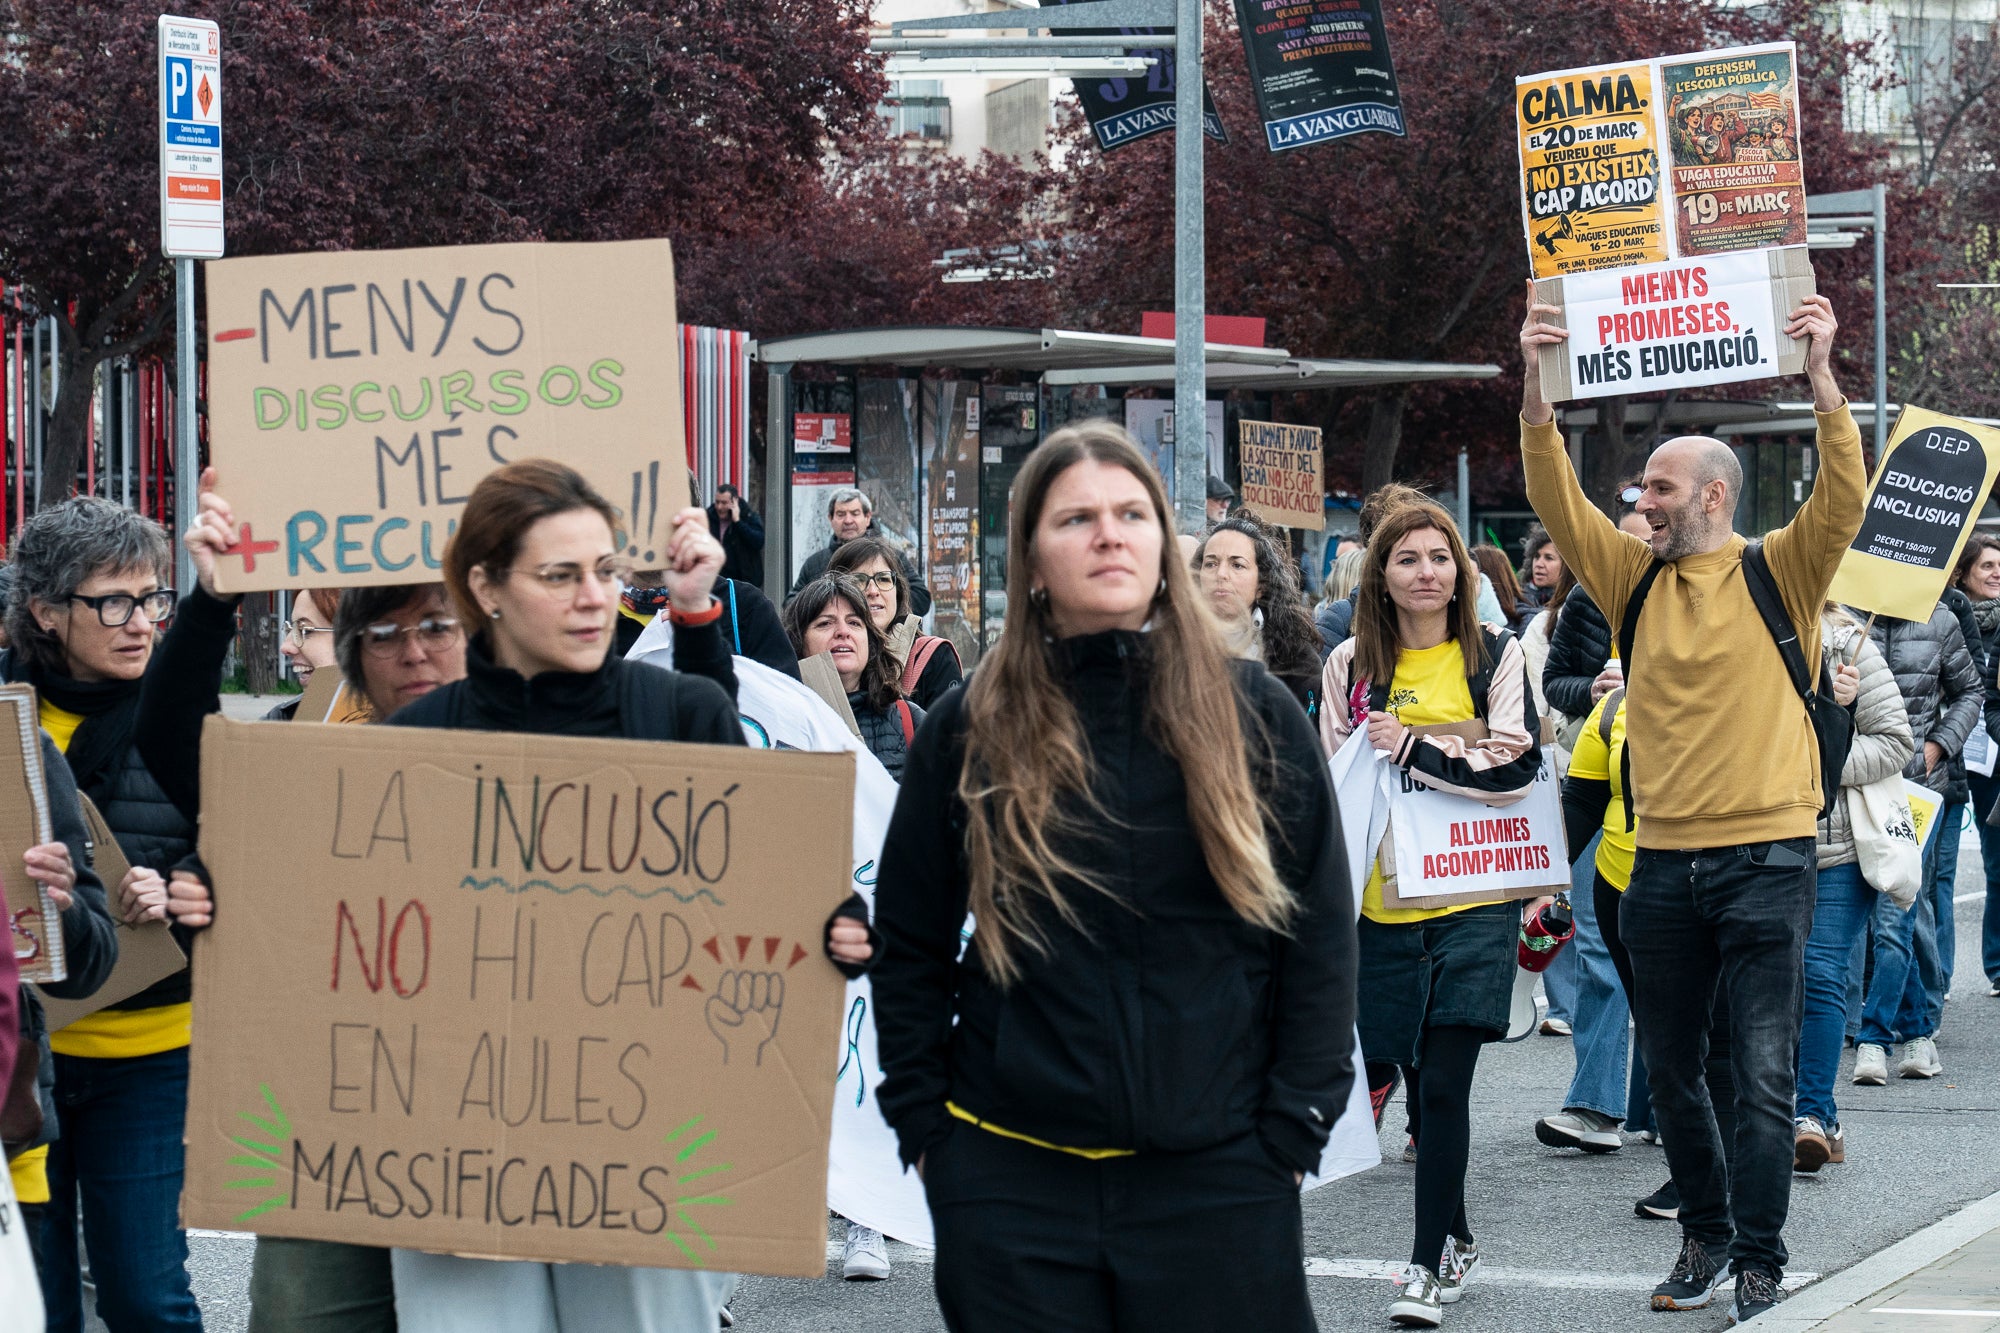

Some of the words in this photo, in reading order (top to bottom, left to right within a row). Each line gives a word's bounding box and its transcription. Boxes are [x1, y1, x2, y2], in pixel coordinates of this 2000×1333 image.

[1275, 4, 1314, 19] QUARTET
[1255, 20, 1287, 35] CLONE
[1310, 24, 1330, 36] NITO
[1330, 21, 1365, 33] FIGUERAS
[1277, 39, 1303, 53] SANT
[1303, 35, 1335, 47] ANDREU
[1282, 49, 1312, 63] PREMI
[1694, 59, 1757, 78] DEFENSEM
[172, 62, 188, 114] P
[1675, 78, 1727, 94] L'ESCOLA
[1727, 70, 1778, 87] PÚBLICA
[1522, 74, 1649, 125] CALMA.
[1102, 119, 1132, 142] LA
[1273, 122, 1303, 144] LA
[1300, 107, 1401, 138] VANGUARDIA
[1530, 136, 1544, 149] EL
[1543, 124, 1576, 151] 20
[1578, 129, 1594, 141] DE
[1596, 121, 1638, 140] MARÇ
[1543, 147, 1590, 164] VEUREU
[1592, 143, 1617, 157] QUE
[1532, 167, 1560, 193] NO
[1563, 152, 1656, 187] EXISTEIX
[1678, 168, 1713, 183] VAGA
[1713, 163, 1778, 179] EDUCATIVA
[1686, 183, 1695, 191] AL
[1725, 175, 1775, 186] OCCIDENTAL!
[1534, 187, 1576, 215] CAP
[1579, 177, 1654, 209] ACORD
[1683, 193, 1720, 226] 19
[1720, 201, 1734, 213] DE
[1735, 190, 1792, 216] MARÇ
[1575, 230, 1608, 243] VAGUES
[1609, 223, 1662, 239] EDUCATIVES
[1710, 225, 1733, 233] EDUCACIÓ
[1623, 237, 1645, 248] MARÇ
[1557, 261, 1570, 271] PER
[1572, 259, 1586, 269] UNA
[1588, 252, 1622, 266] EDUCACIÓ
[1623, 252, 1648, 262] DIGNA,
[1621, 266, 1709, 306] MENYS
[1597, 300, 1740, 346] PROMESES,
[1577, 343, 1633, 386] MÉS
[1639, 327, 1768, 378] EDUCACIÓ.
[254, 358, 625, 431] DISCURSOS
[1242, 422, 1287, 450] L'ALUMNAT
[1289, 427, 1318, 452] D'AVUI
[1925, 431, 1971, 456] D.E.P
[1242, 445, 1254, 464] LA
[1255, 447, 1295, 471] SOCIETAT
[1297, 453, 1316, 474] DEL
[1267, 468, 1281, 488] NO
[1296, 472, 1315, 493] CAP
[1883, 469, 1974, 504] EDUCACIÓ
[933, 507, 940, 520] EL
[940, 507, 969, 520] TRANSPORT
[1872, 493, 1962, 528] INCLUSIVA
[933, 523, 945, 537] QUE
[937, 538, 945, 550] AL
[1867, 544, 1893, 559] SENSE
[1893, 551, 1931, 567] RECURSOS
[1874, 532, 1905, 550] DECRET
[1904, 540, 1937, 555] 150/2017
[331, 768, 411, 863] LA
[1449, 816, 1531, 848] ALUMNES
[1423, 844, 1551, 880] ACOMPANYATS
[330, 897, 432, 1000] NO
[580, 911, 693, 1009] CAP
[328, 1022, 418, 1117] EN
[458, 1031, 651, 1131] AULES
